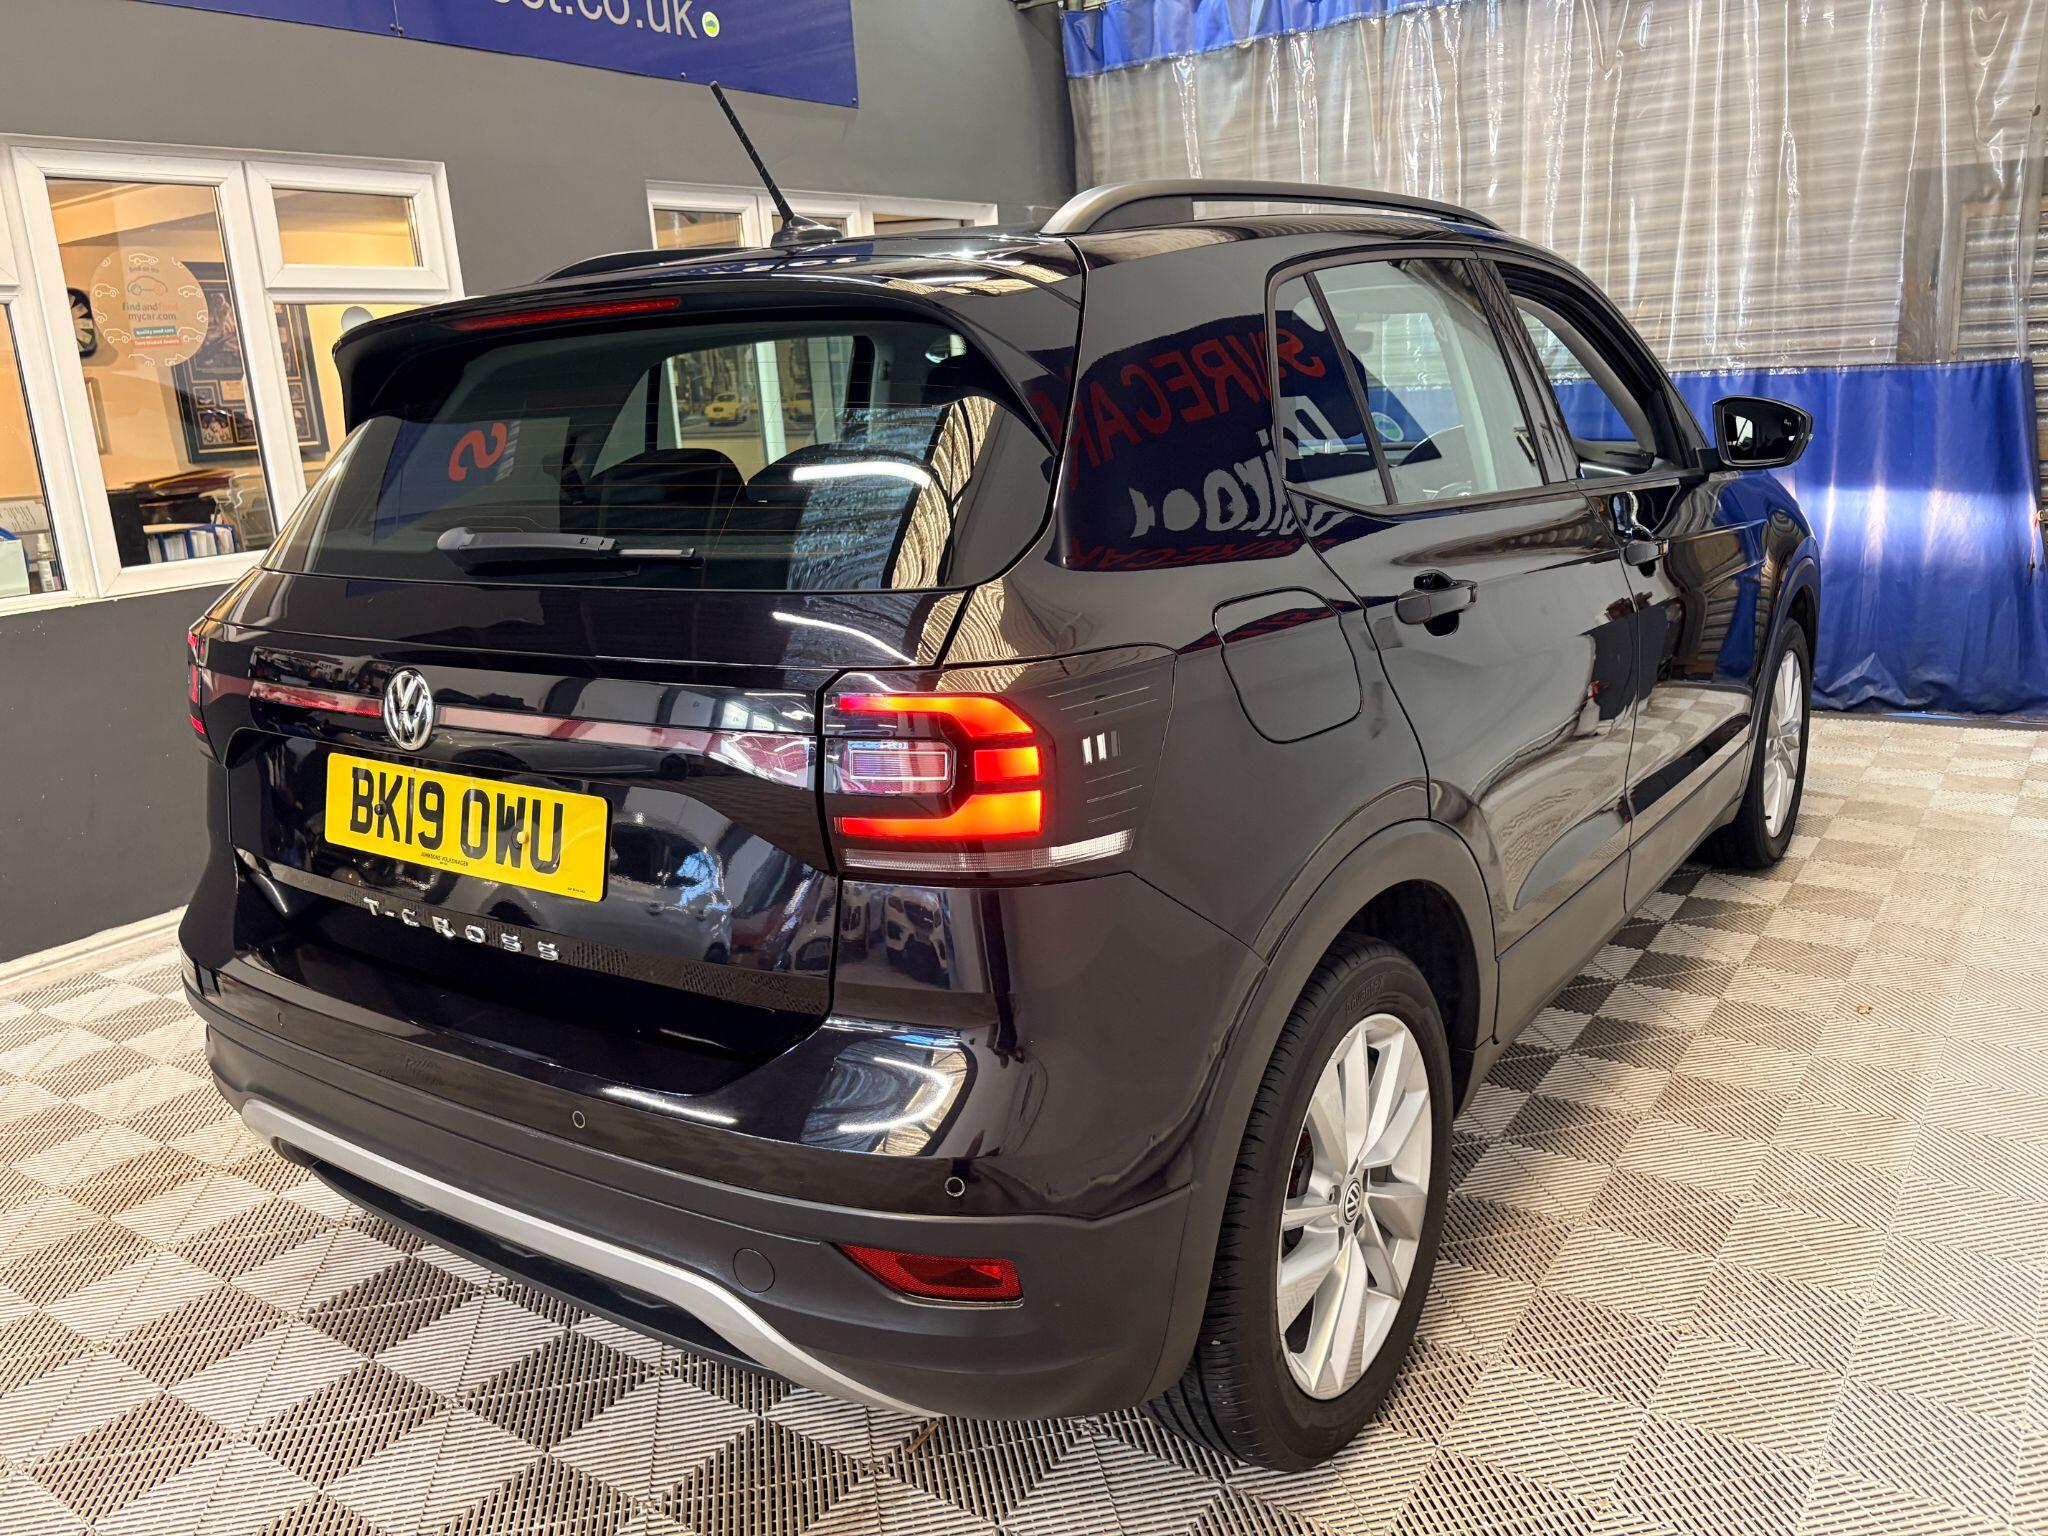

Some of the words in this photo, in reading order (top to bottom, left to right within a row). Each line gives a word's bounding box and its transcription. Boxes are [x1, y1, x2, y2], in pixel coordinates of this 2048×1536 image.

[350, 766, 446, 851] BK19
[460, 788, 564, 875] OWU
[363, 896, 560, 961] T-CROSS
